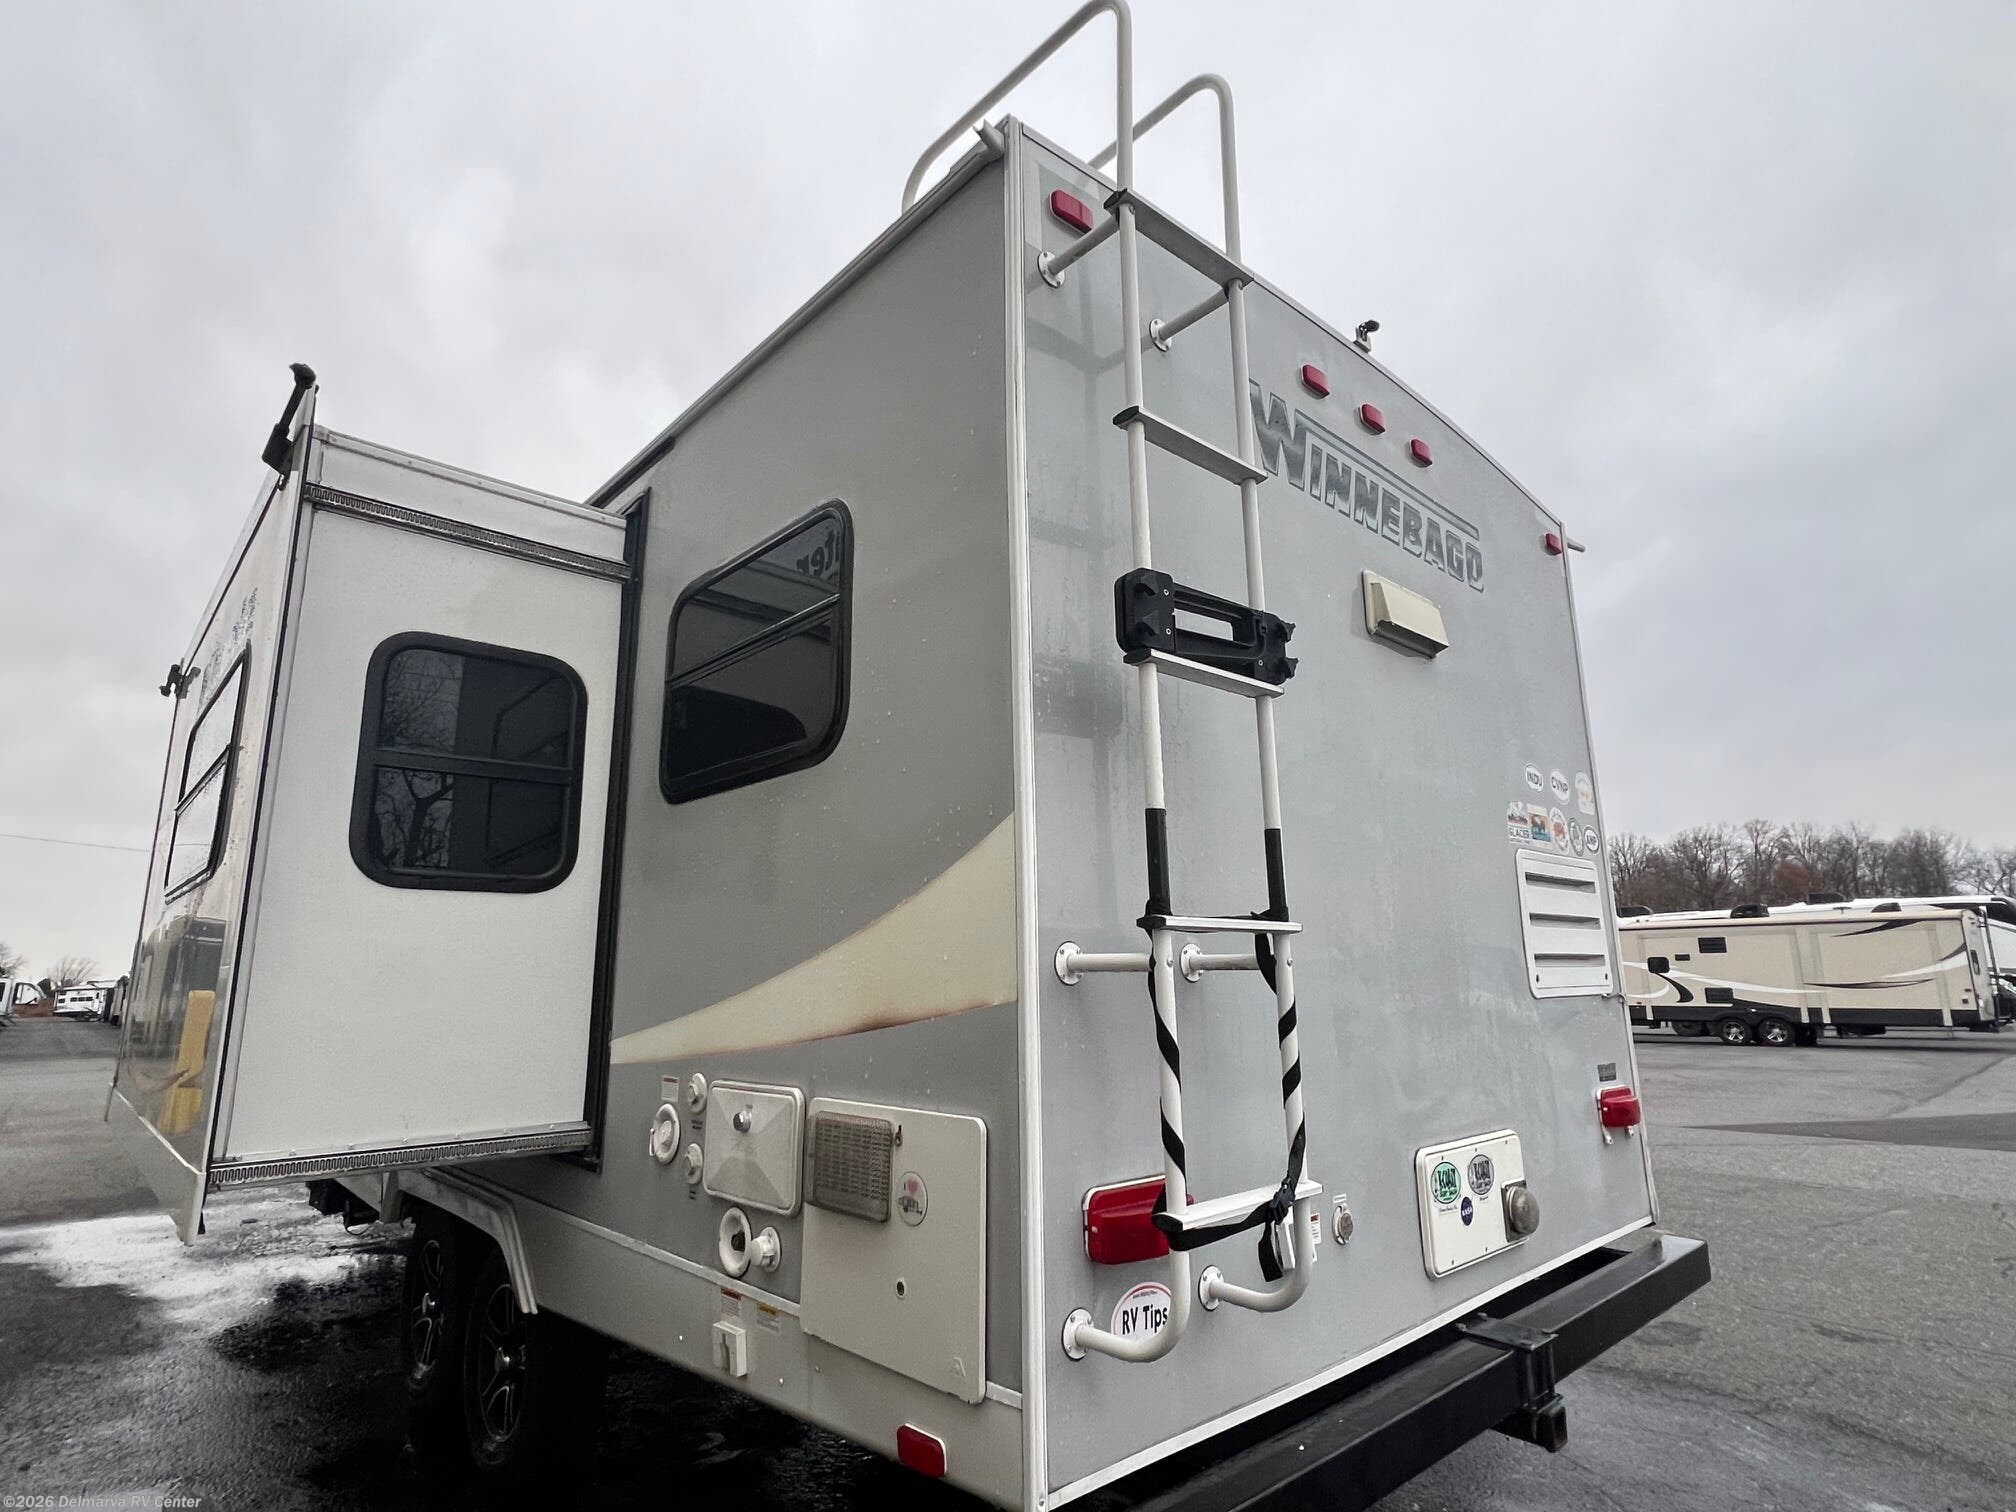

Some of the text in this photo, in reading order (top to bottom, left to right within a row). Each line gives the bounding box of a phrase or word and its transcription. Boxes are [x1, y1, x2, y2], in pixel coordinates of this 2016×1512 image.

[1249, 377, 1485, 593] WINNEBAGO
[1122, 1303, 1168, 1335] RV Tips
